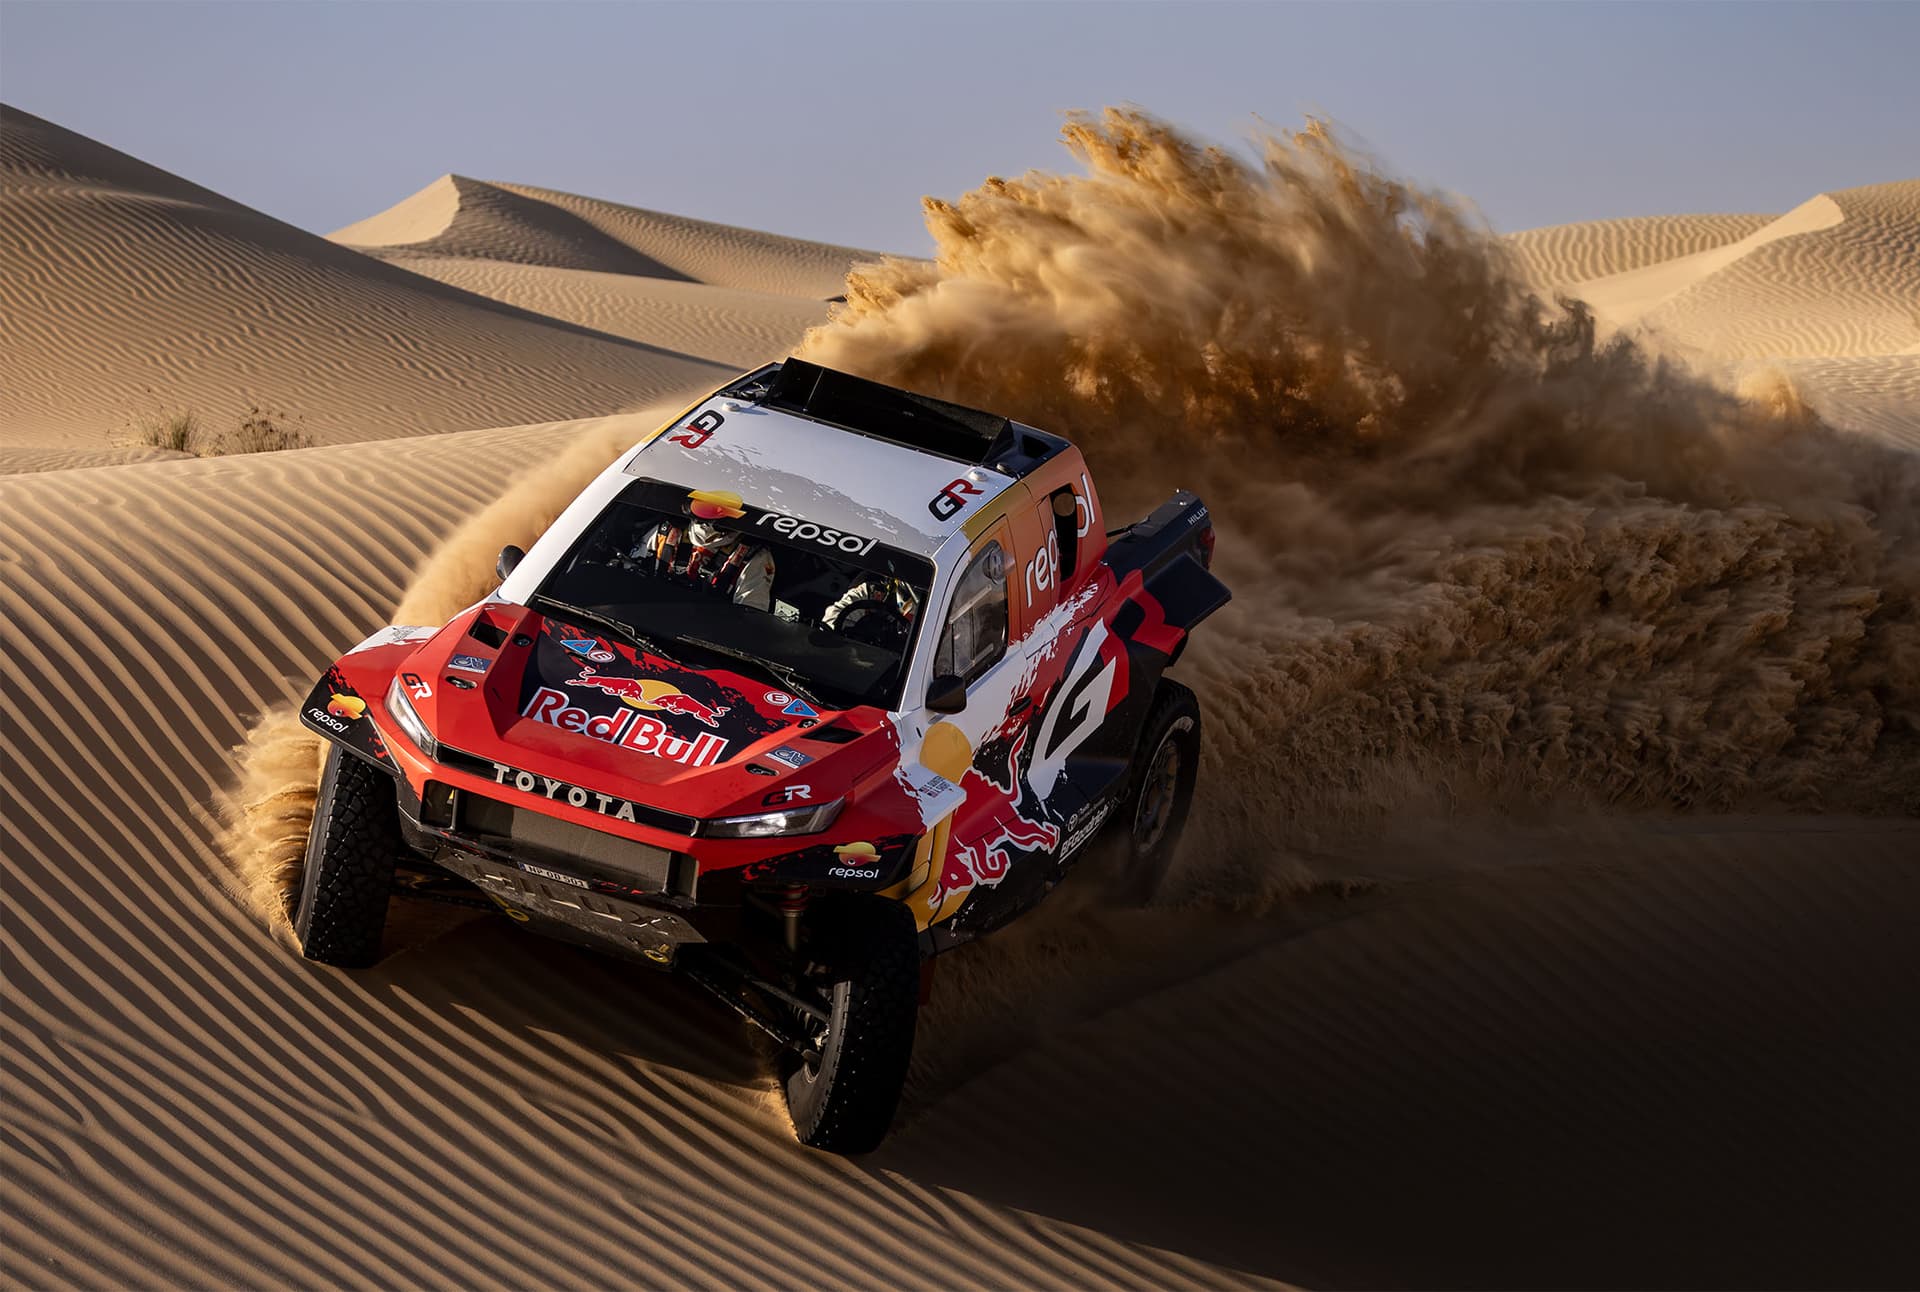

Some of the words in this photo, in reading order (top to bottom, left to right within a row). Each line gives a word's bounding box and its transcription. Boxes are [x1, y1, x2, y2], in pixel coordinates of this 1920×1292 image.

[668, 410, 725, 449] GR
[928, 478, 985, 522] GR
[1187, 506, 1208, 525] HILUX
[756, 511, 880, 557] repsol
[1025, 472, 1096, 608] repol
[401, 672, 432, 700] GR
[308, 707, 349, 733] repsol
[521, 686, 634, 743] Red
[620, 713, 730, 767] Bull
[493, 762, 637, 823] TOYOTA
[762, 784, 812, 807] GR
[828, 867, 880, 878] repsol
